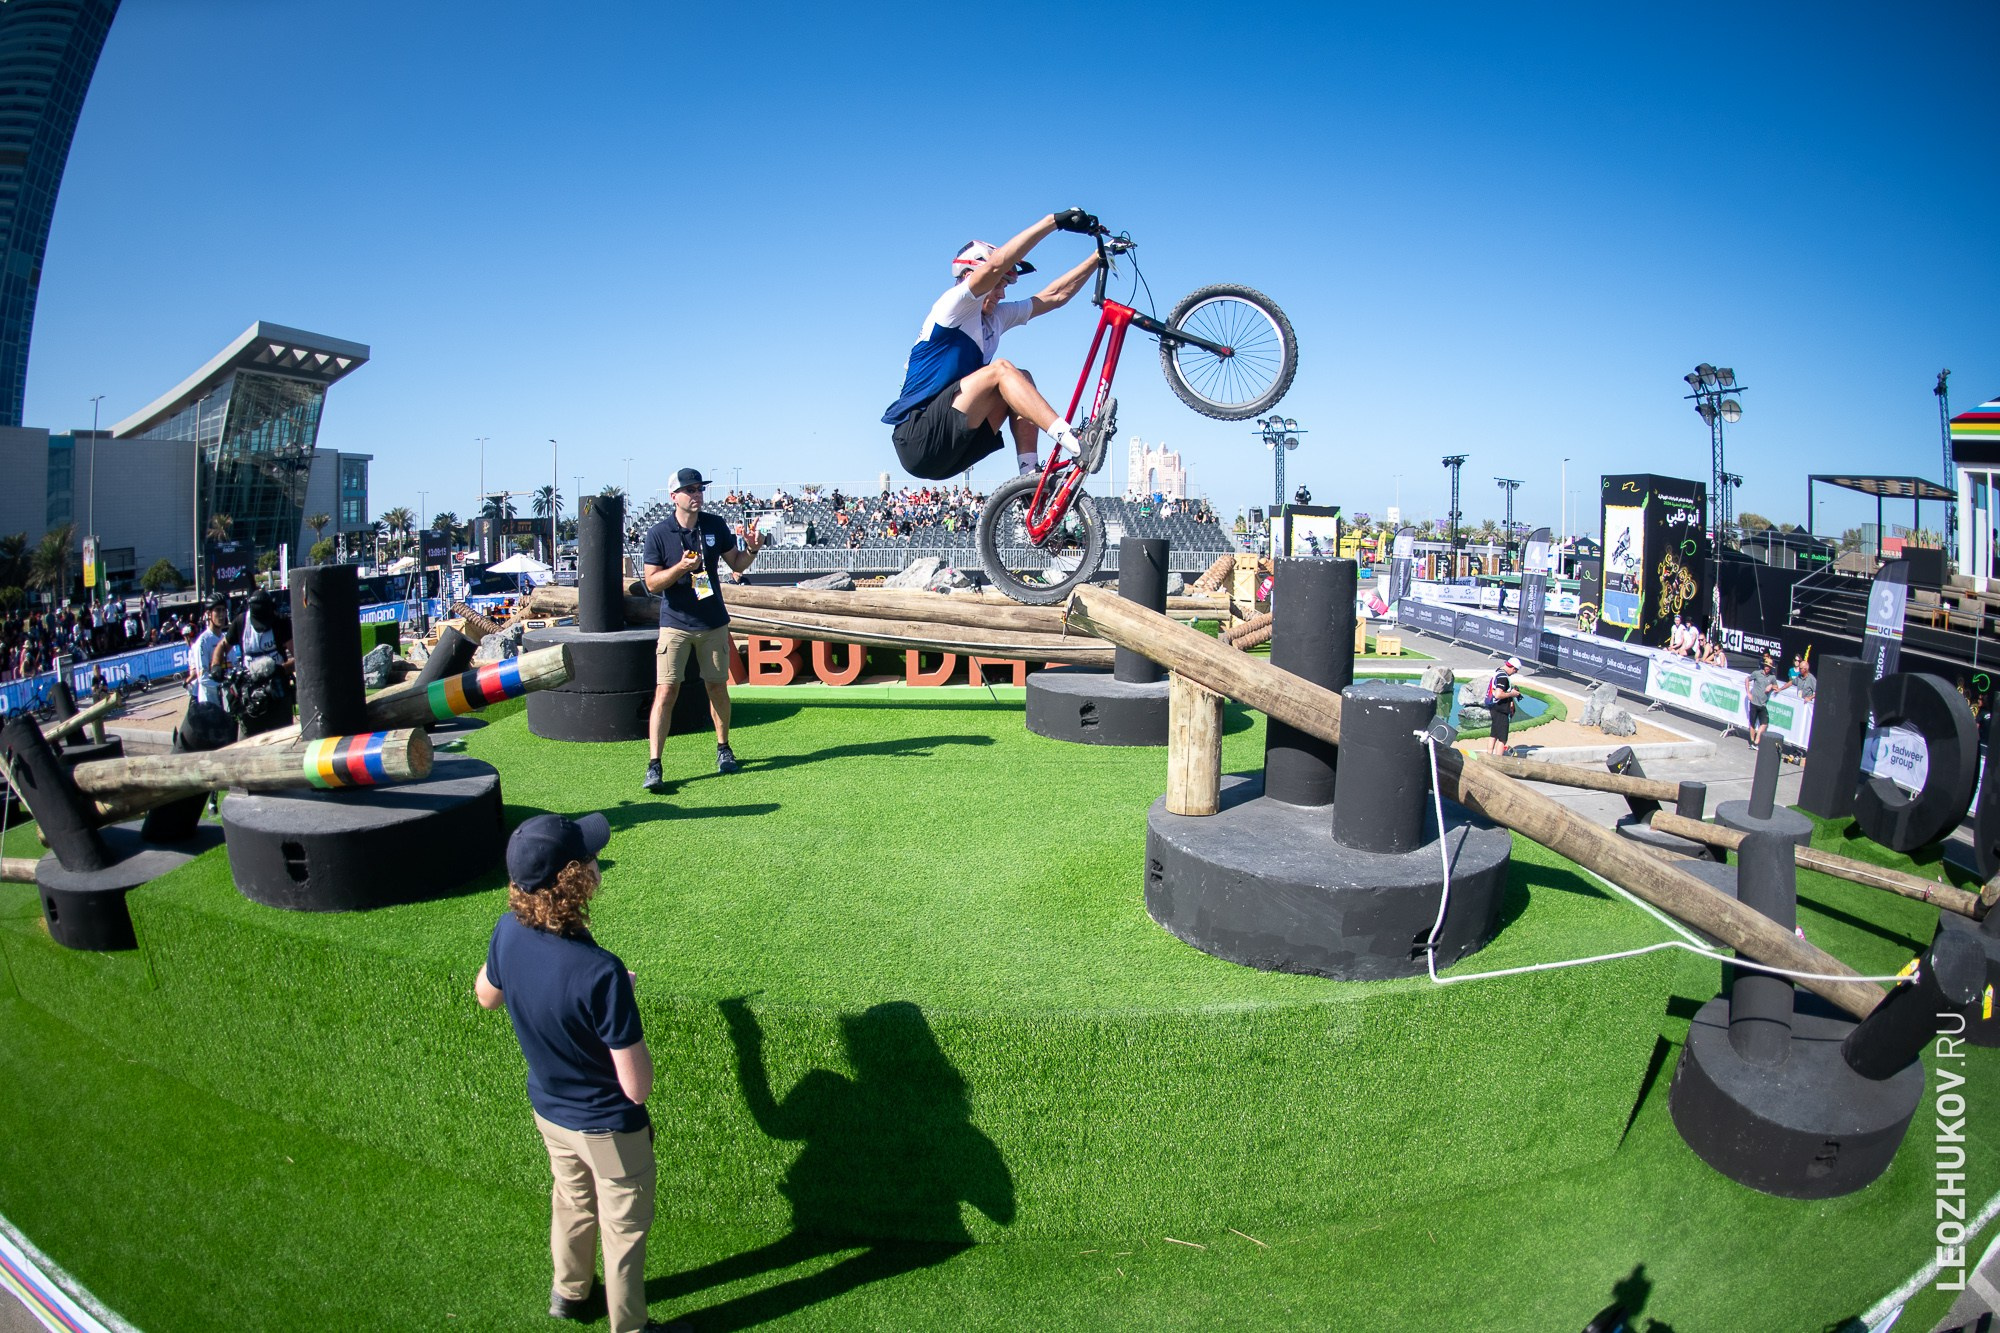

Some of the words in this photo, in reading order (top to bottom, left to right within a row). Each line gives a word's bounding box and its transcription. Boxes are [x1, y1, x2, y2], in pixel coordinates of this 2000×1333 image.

[1666, 508, 1686, 527] ظبي
[1688, 509, 1699, 527] أبو
[1530, 546, 1541, 563] 4
[1879, 589, 1894, 620] 3
[360, 608, 396, 623] HIMANO
[1720, 631, 1740, 648] UCI
[1877, 626, 1891, 637] UCI
[1743, 643, 1760, 652] WORLD
[1753, 637, 1770, 647] URBAN
[1769, 641, 1782, 650] CYCL
[1572, 648, 1582, 657] bike
[1581, 651, 1591, 660] abu
[1590, 653, 1604, 664] dhabi
[1606, 657, 1617, 668] bike
[1616, 660, 1627, 670] abu
[1627, 663, 1642, 675] dhabi
[1714, 688, 1725, 696] ABU
[1723, 691, 1739, 701] DHABI
[1775, 706, 1792, 718] DHABI
[1892, 743, 1924, 763] tadweer
[1890, 755, 1914, 770] group
